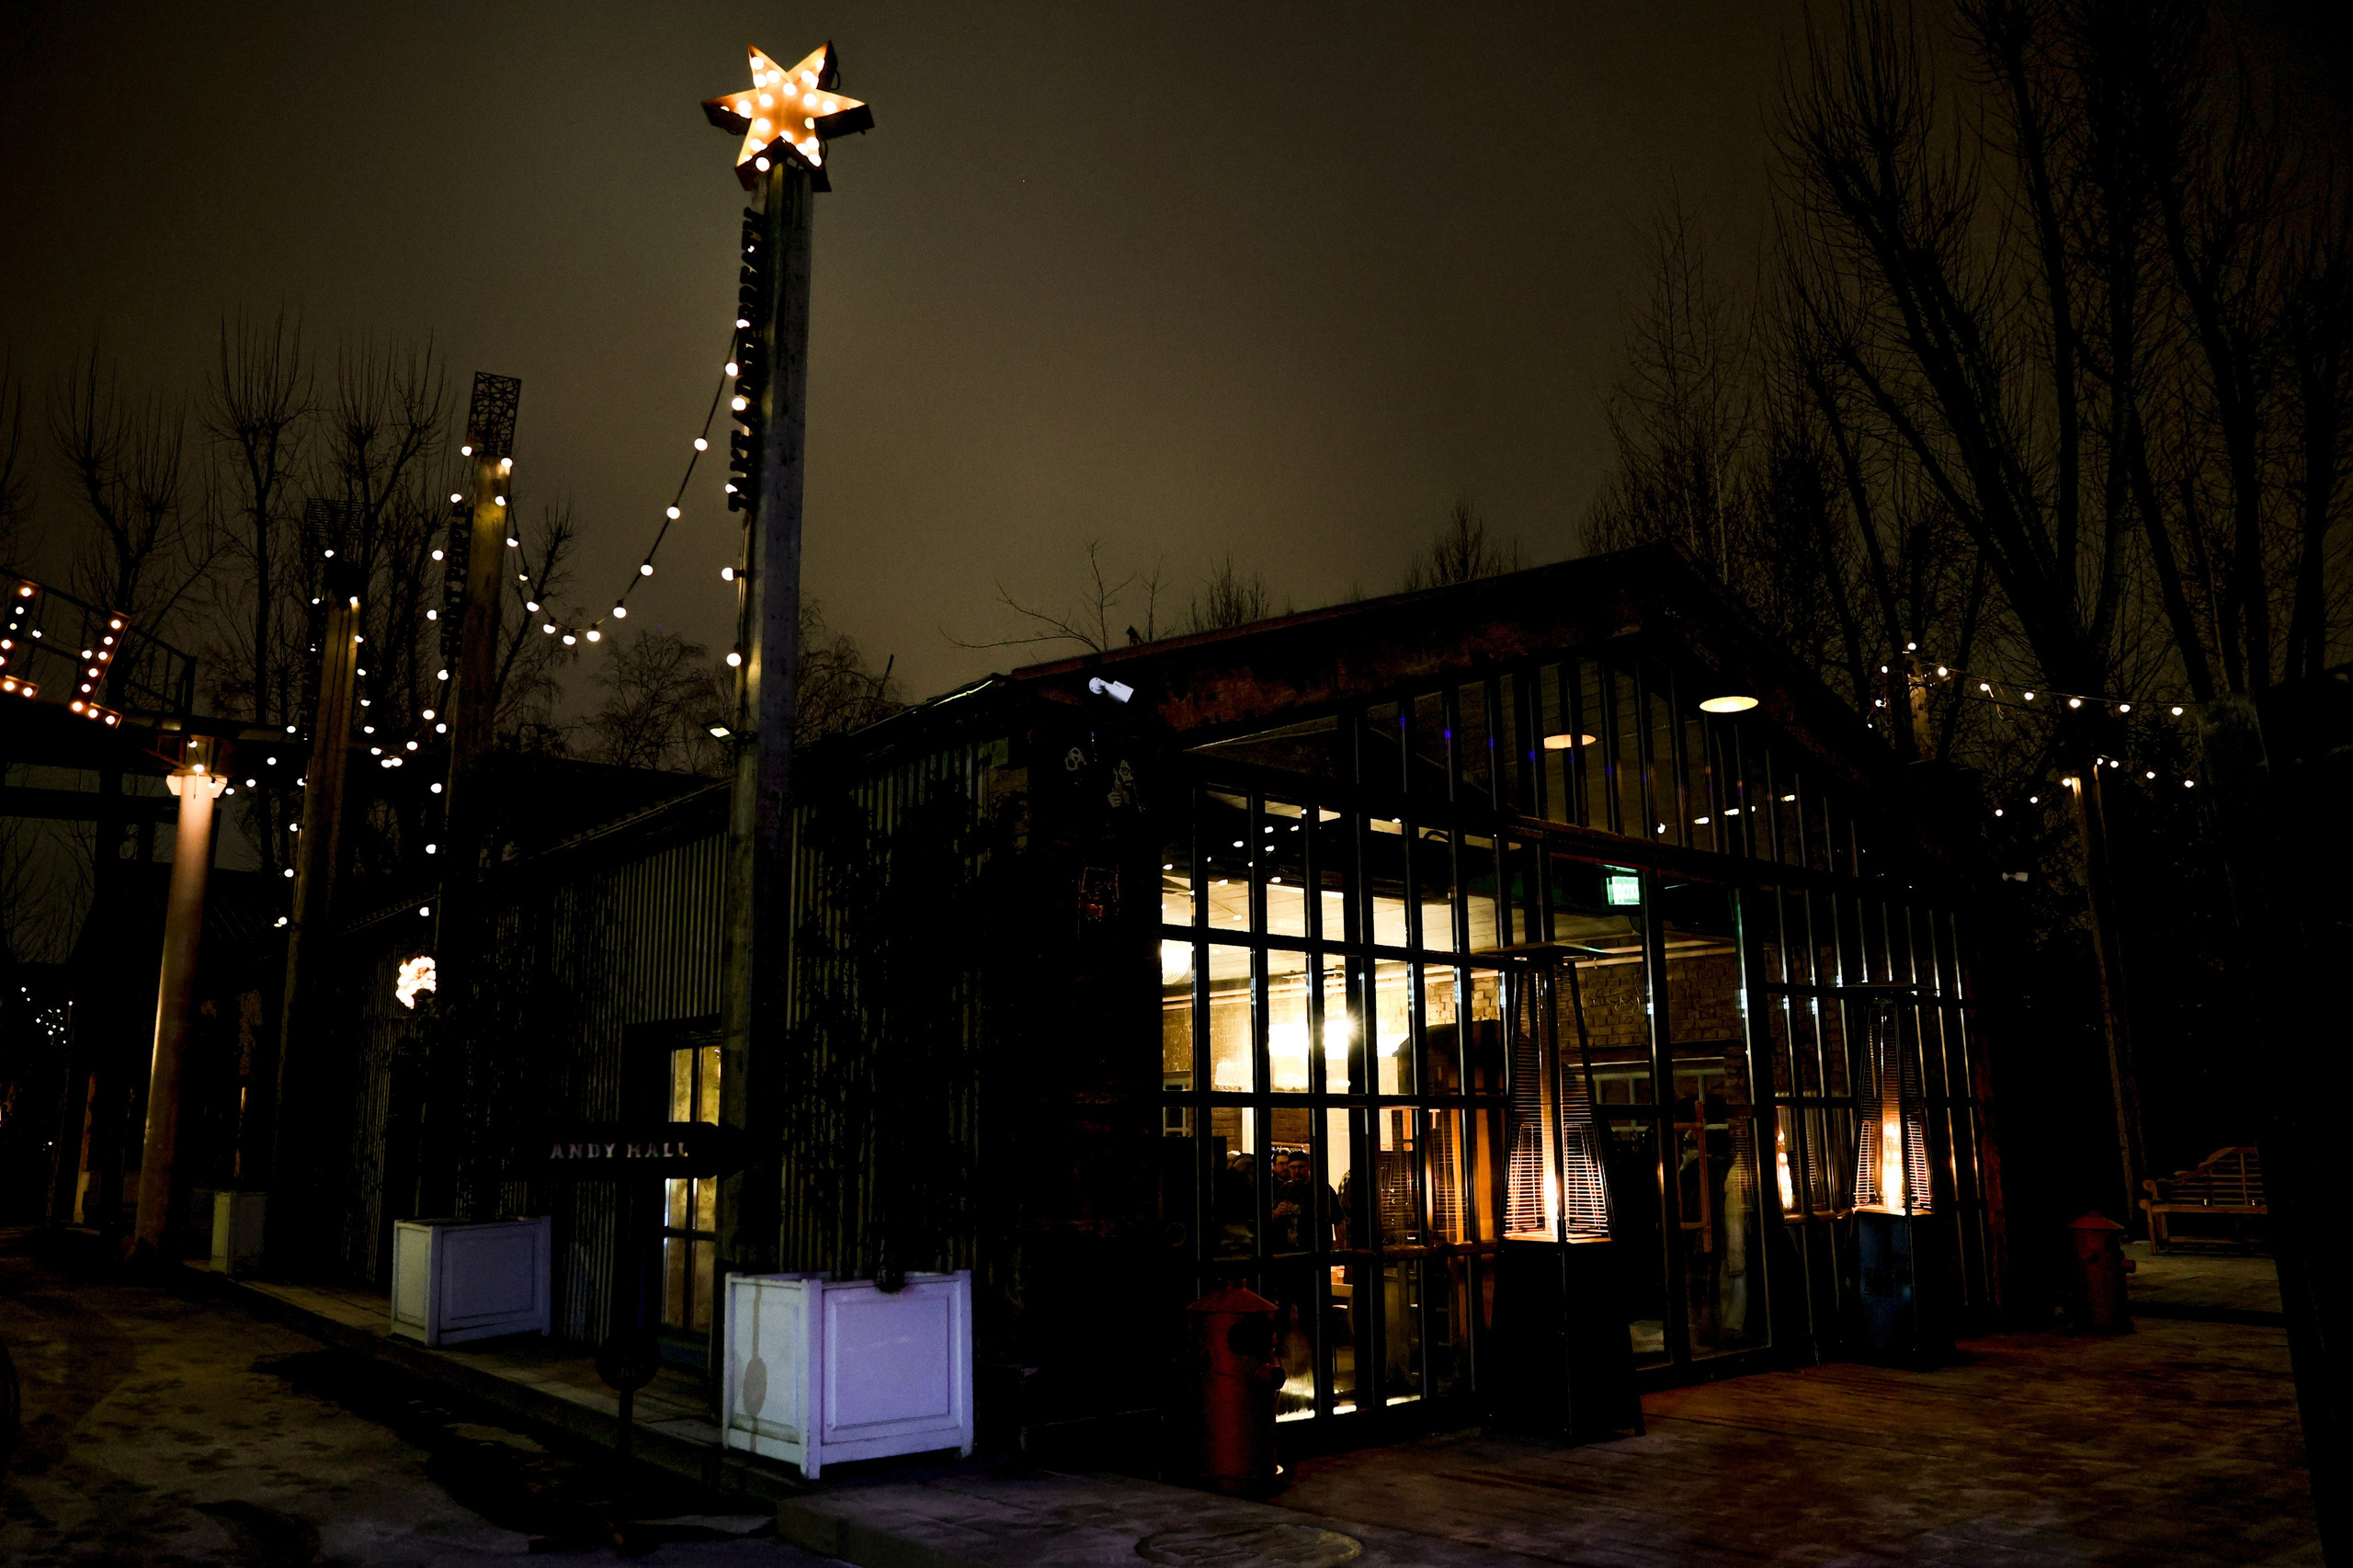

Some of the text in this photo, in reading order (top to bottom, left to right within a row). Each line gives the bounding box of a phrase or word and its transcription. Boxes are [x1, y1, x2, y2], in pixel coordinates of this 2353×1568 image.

[726, 430, 758, 513] TAKE
[549, 1142, 689, 1160] ANDY HALL
